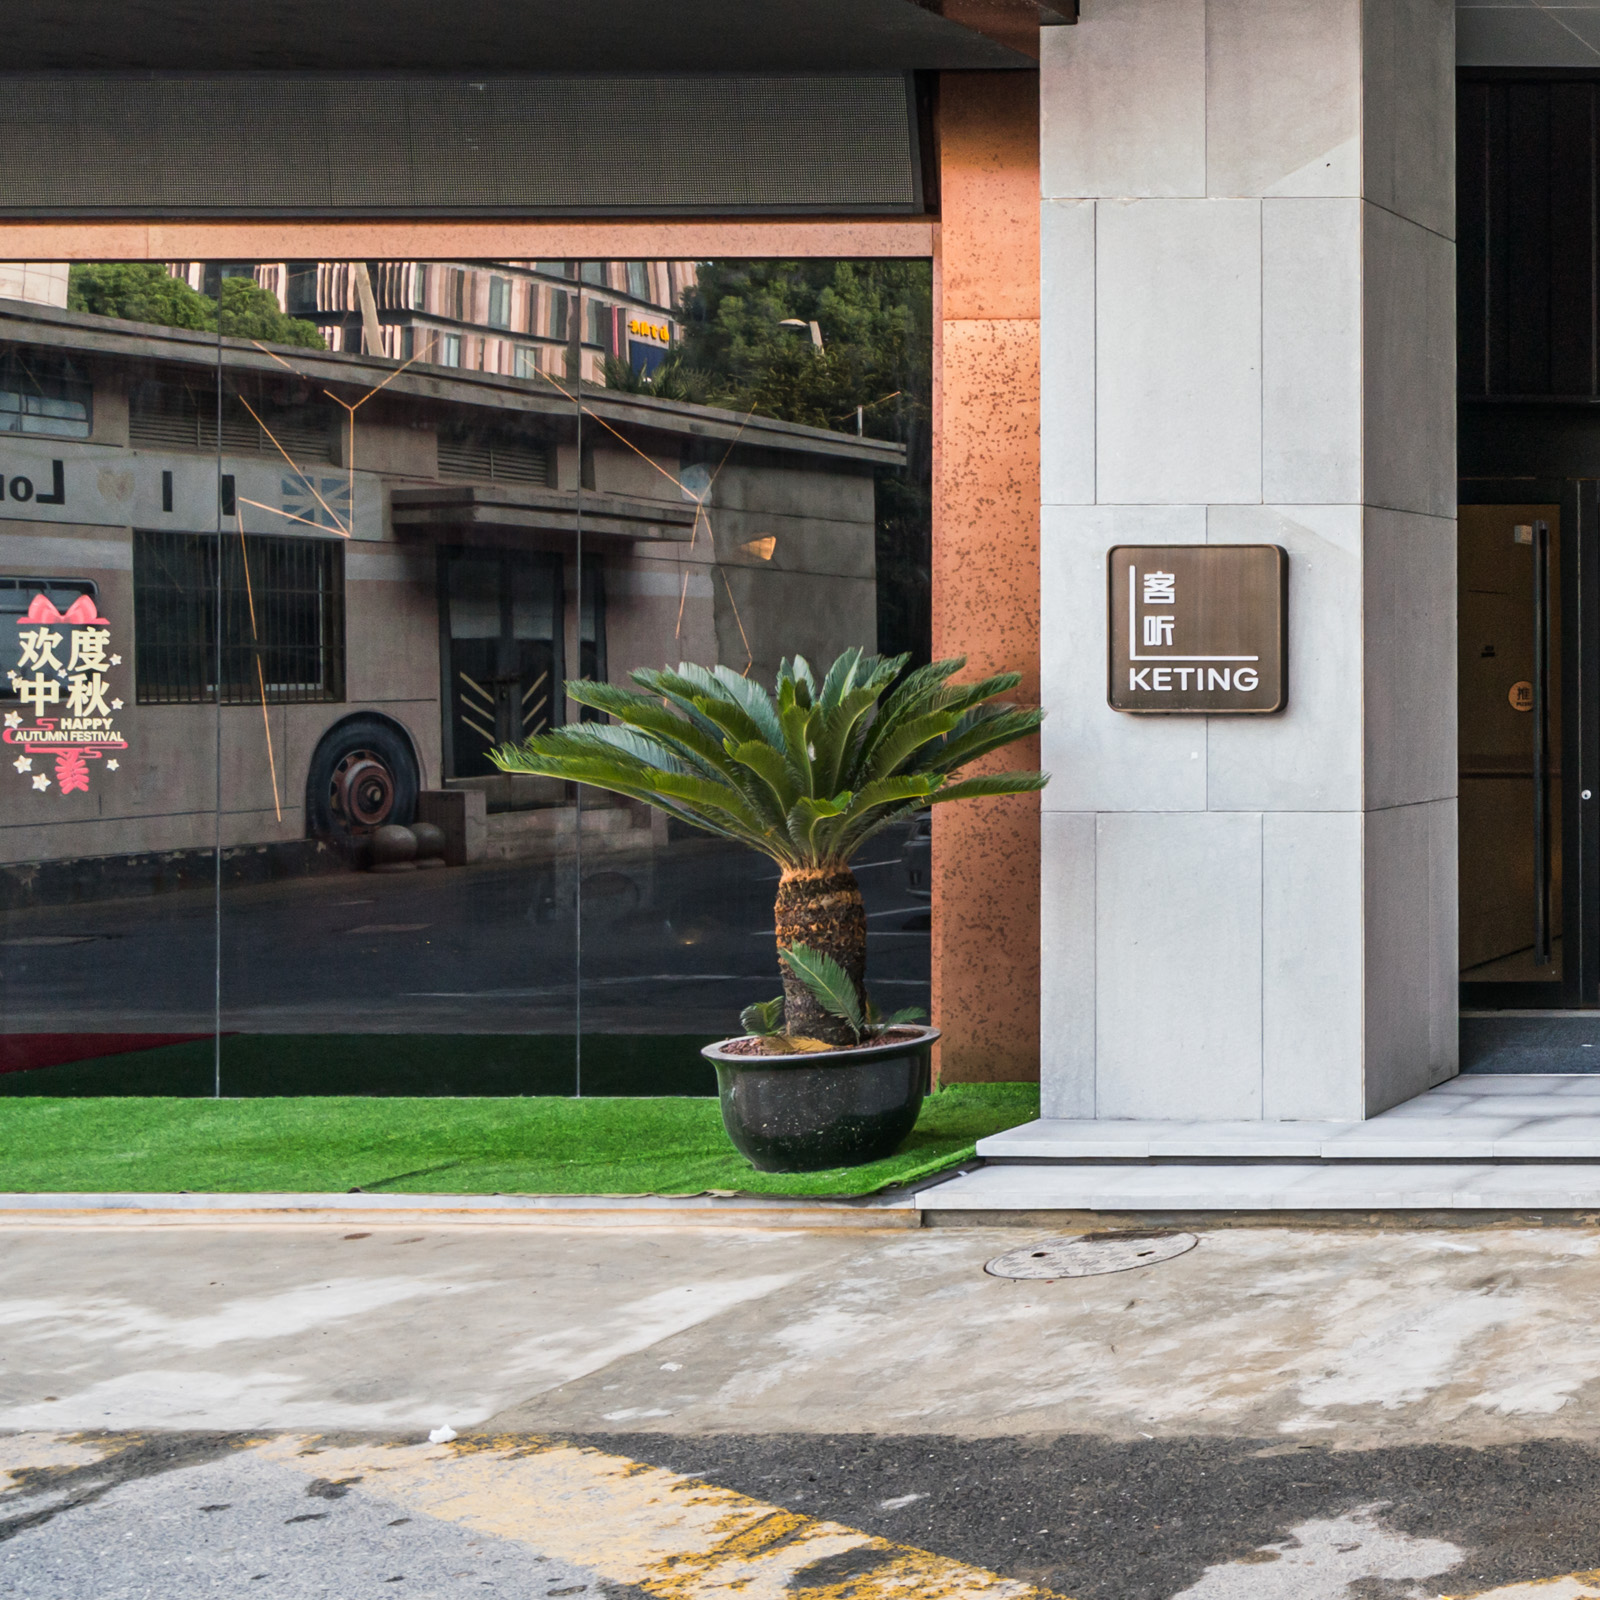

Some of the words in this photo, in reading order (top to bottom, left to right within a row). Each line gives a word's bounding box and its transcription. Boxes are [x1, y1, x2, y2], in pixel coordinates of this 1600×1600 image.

[17, 626, 111, 672] 欢度
[1129, 667, 1259, 691] KETING
[18, 672, 111, 717] 中秋
[60, 717, 114, 730] HAPPY
[15, 731, 69, 742] AUTUMN
[70, 731, 124, 742] FESTIVAL
